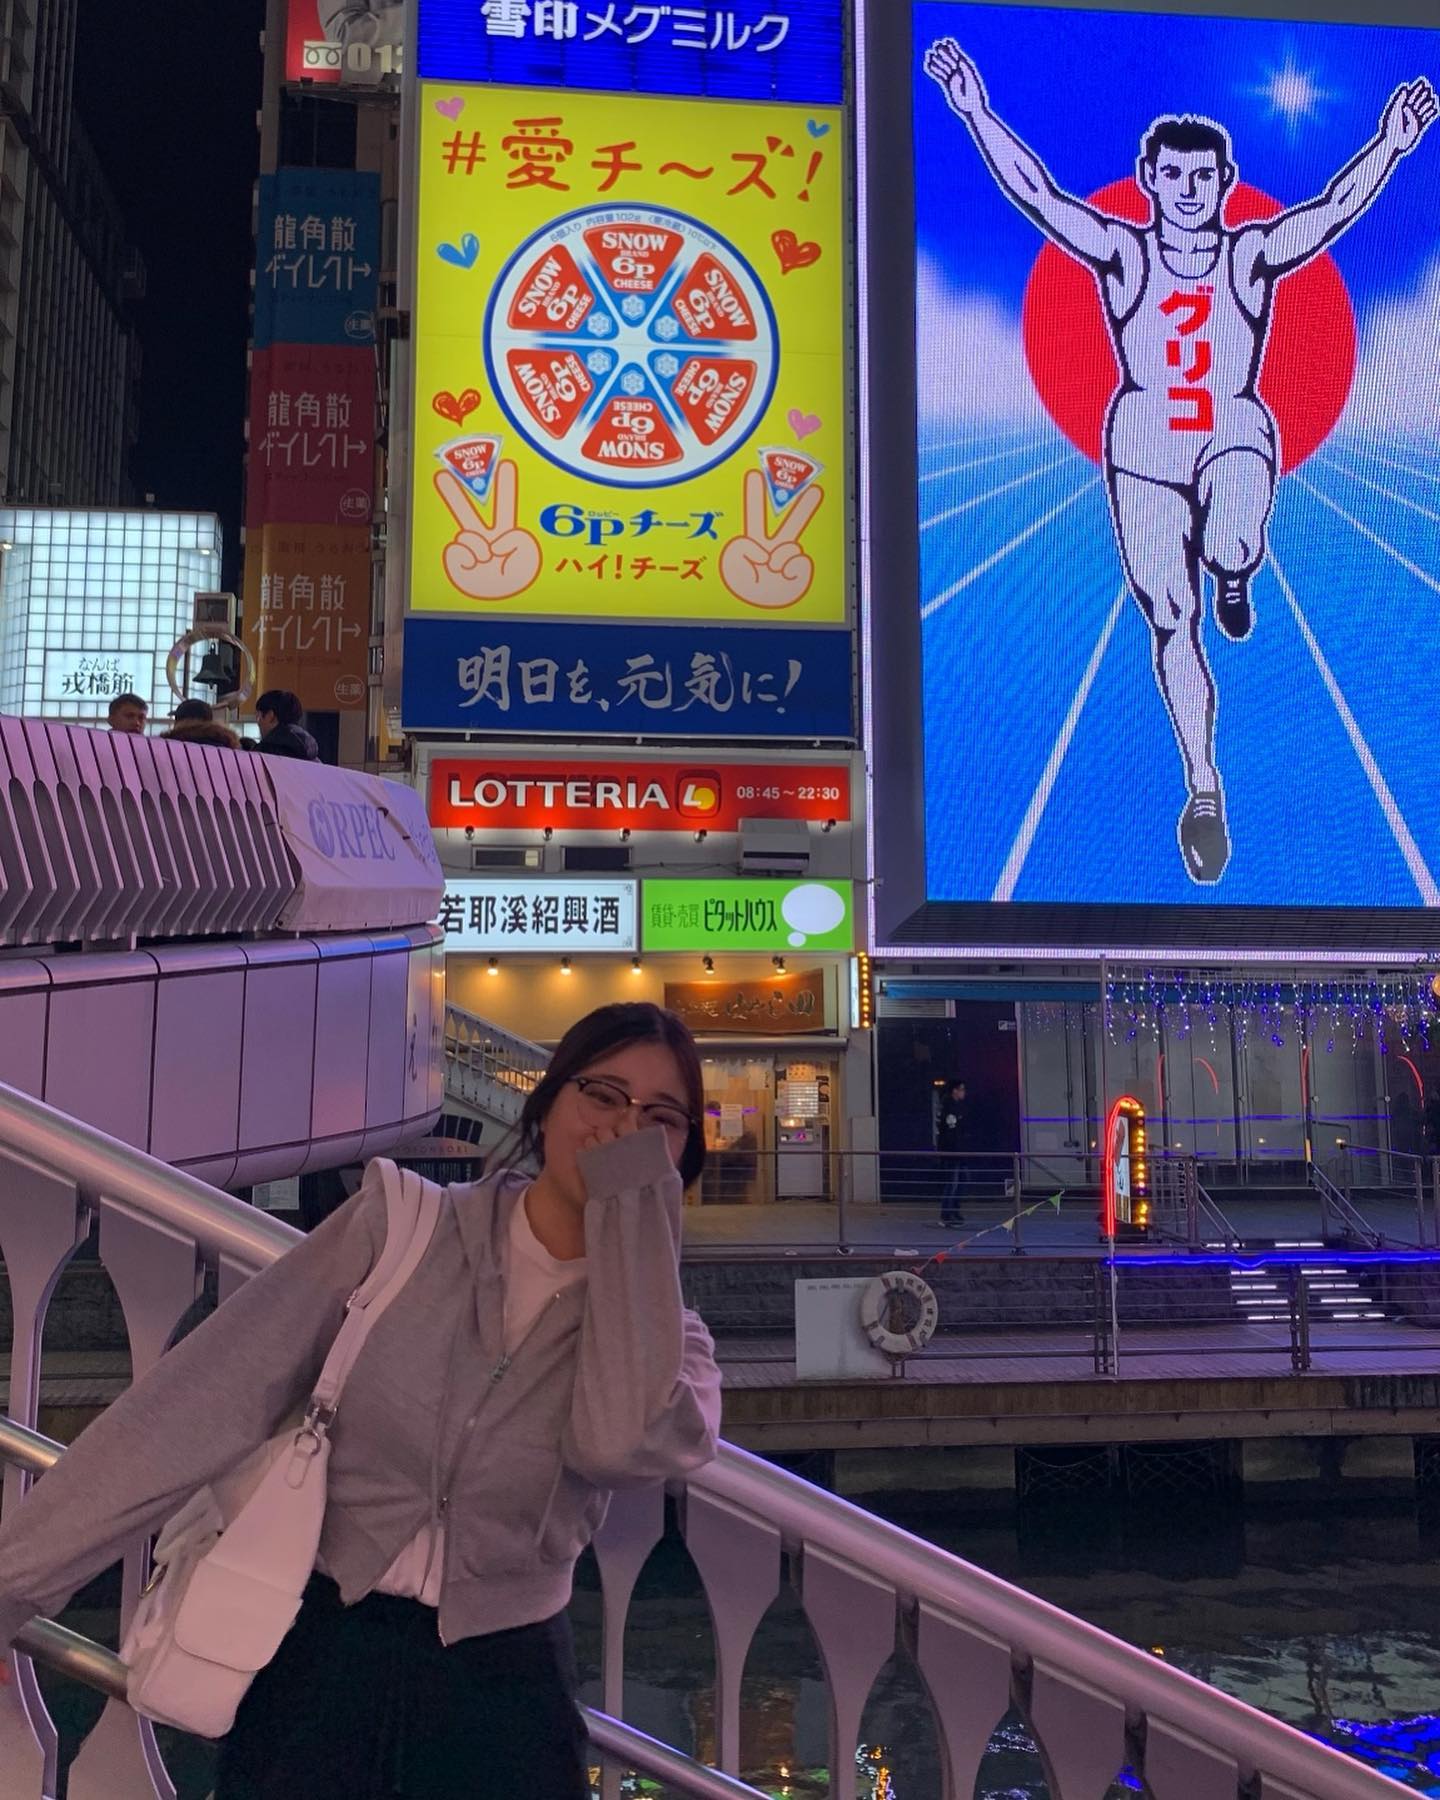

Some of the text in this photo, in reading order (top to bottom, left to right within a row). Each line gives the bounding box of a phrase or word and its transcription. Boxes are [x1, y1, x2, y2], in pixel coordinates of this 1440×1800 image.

[480, 0, 790, 53] 雪印メグミルク
[273, 214, 357, 252] 龍角散
[602, 232, 669, 251] SNOW
[619, 250, 650, 258] BRAND
[517, 256, 563, 318] SNOW
[613, 278, 655, 290] CHEESE
[704, 268, 752, 328] SNOW
[564, 293, 593, 330] CHEESE
[674, 299, 702, 336] CHEESE
[565, 354, 592, 393] CHEESE
[1159, 285, 1215, 432] グリコ
[514, 362, 562, 424] SNOW
[675, 360, 701, 397] CHEESE
[267, 390, 352, 429] 龍角散
[612, 401, 654, 413] CHEESE
[704, 371, 748, 434] SNOW
[454, 443, 487, 460] SNOW
[598, 440, 665, 460] SNOW
[617, 433, 648, 443] BRAND
[773, 456, 808, 472] SNOW
[555, 554, 708, 581] ハイ!チーズ
[260, 574, 347, 611] 龍角散
[78, 656, 120, 671] なんば
[457, 645, 803, 714] 明日を、元気に!
[61, 672, 135, 696] 戎橋筋
[450, 780, 670, 809] LOTTERIA
[704, 897, 778, 932] ピタットハウス
